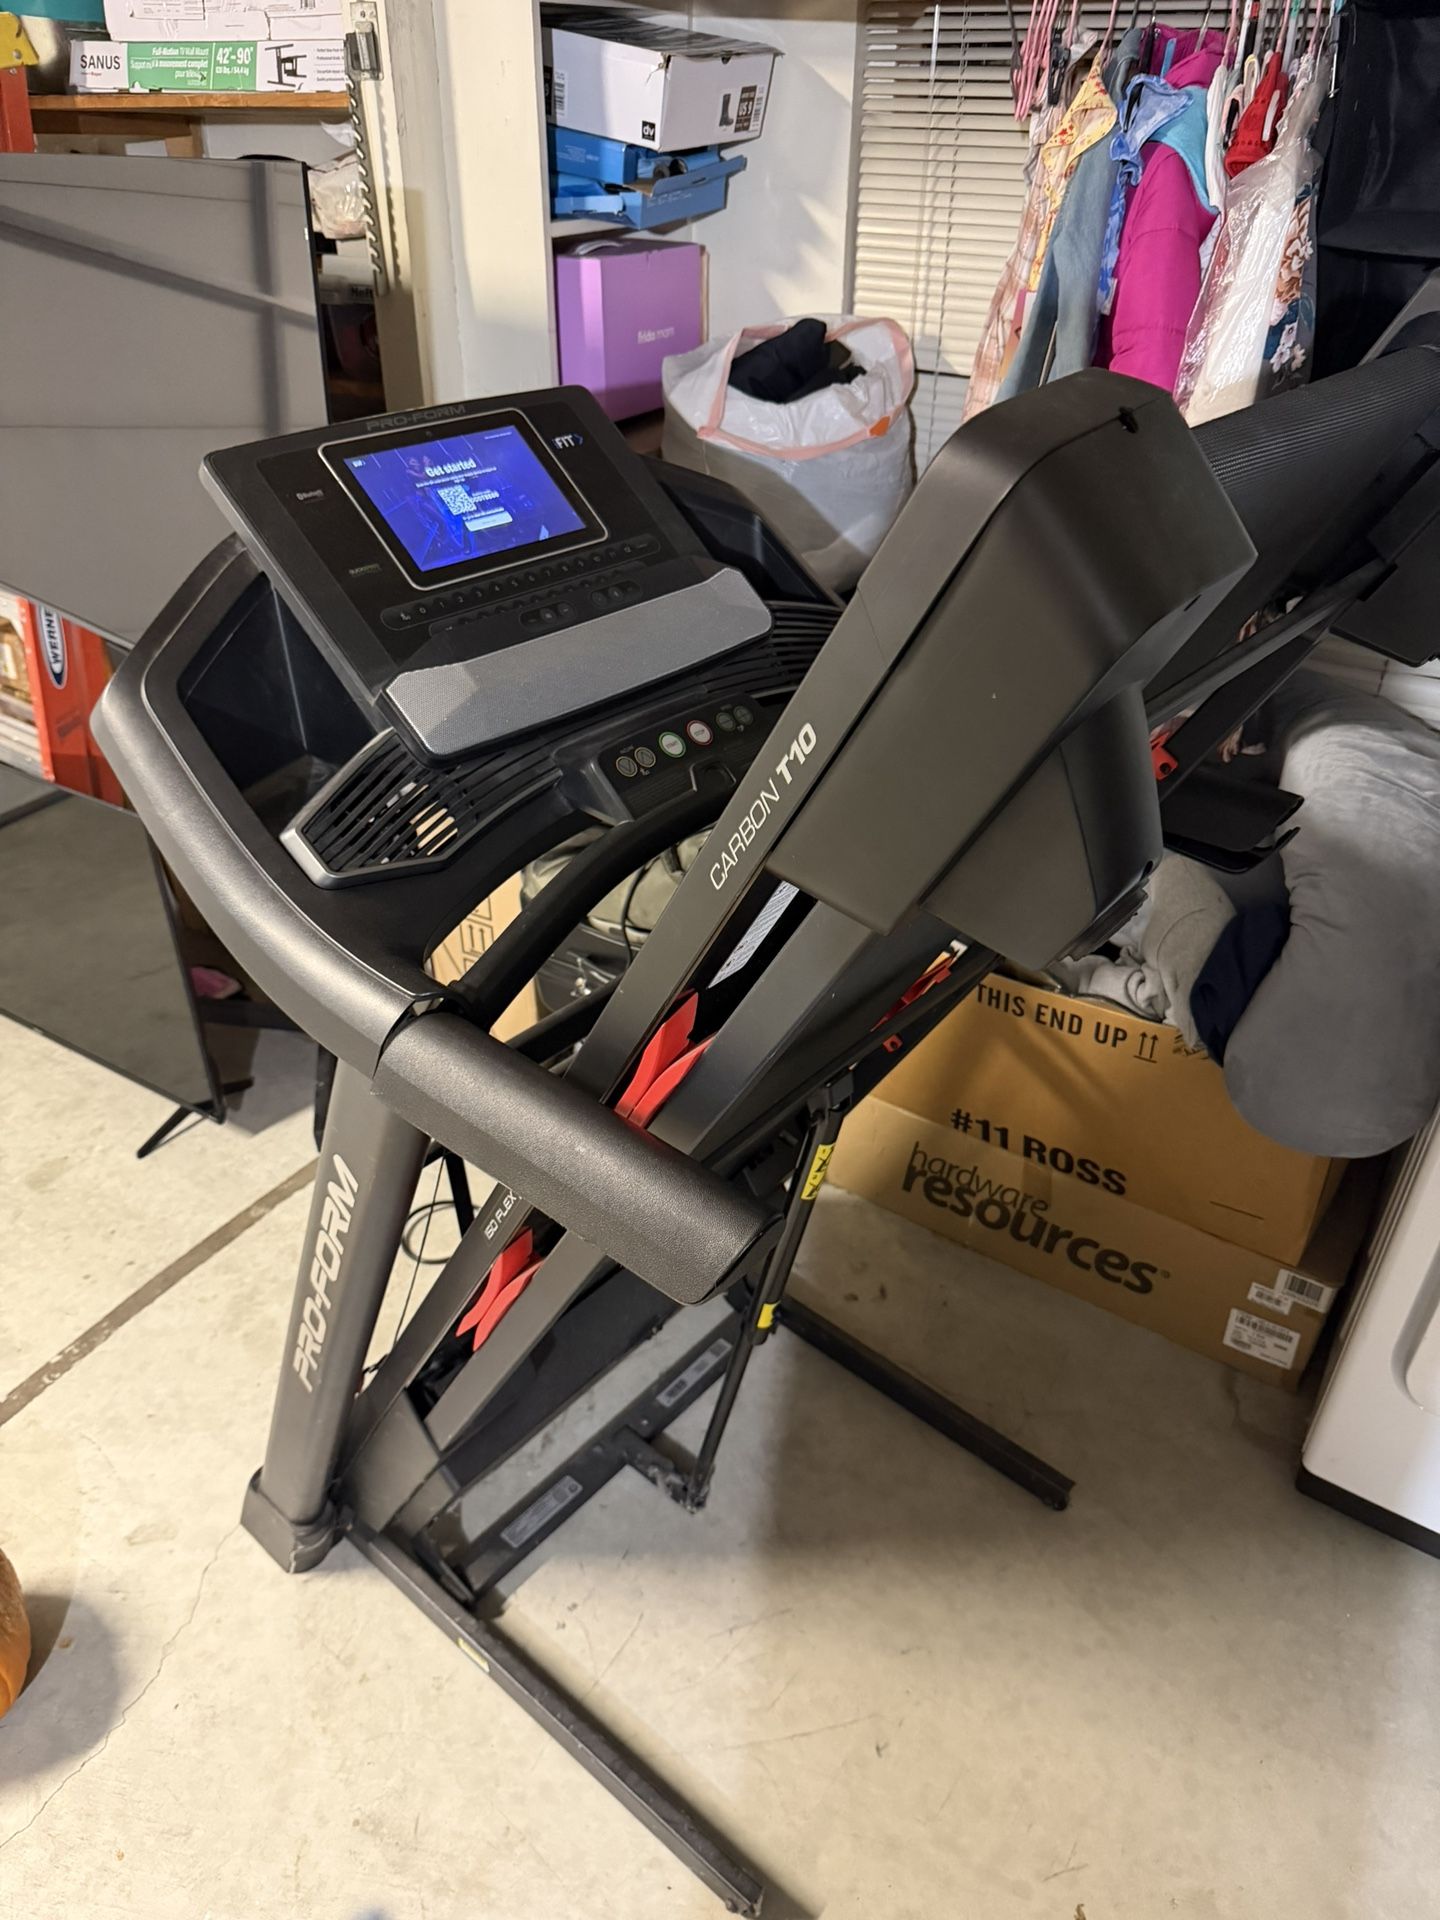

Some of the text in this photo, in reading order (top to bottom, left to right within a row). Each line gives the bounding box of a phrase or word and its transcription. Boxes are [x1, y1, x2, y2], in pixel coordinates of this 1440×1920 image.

[80, 54, 121, 70] SANUS
[425, 465, 445, 478] Get
[443, 457, 477, 474] started
[709, 778, 780, 890] CARBON
[775, 722, 817, 784] T10
[976, 983, 1128, 1048] THIS END UP
[908, 1140, 1050, 1218] hardware
[950, 1108, 1128, 1196] #11 ROSS
[484, 1190, 517, 1240] ISO FLEX
[902, 1163, 1158, 1295] resources
[293, 1153, 359, 1393] PRO-FORM
